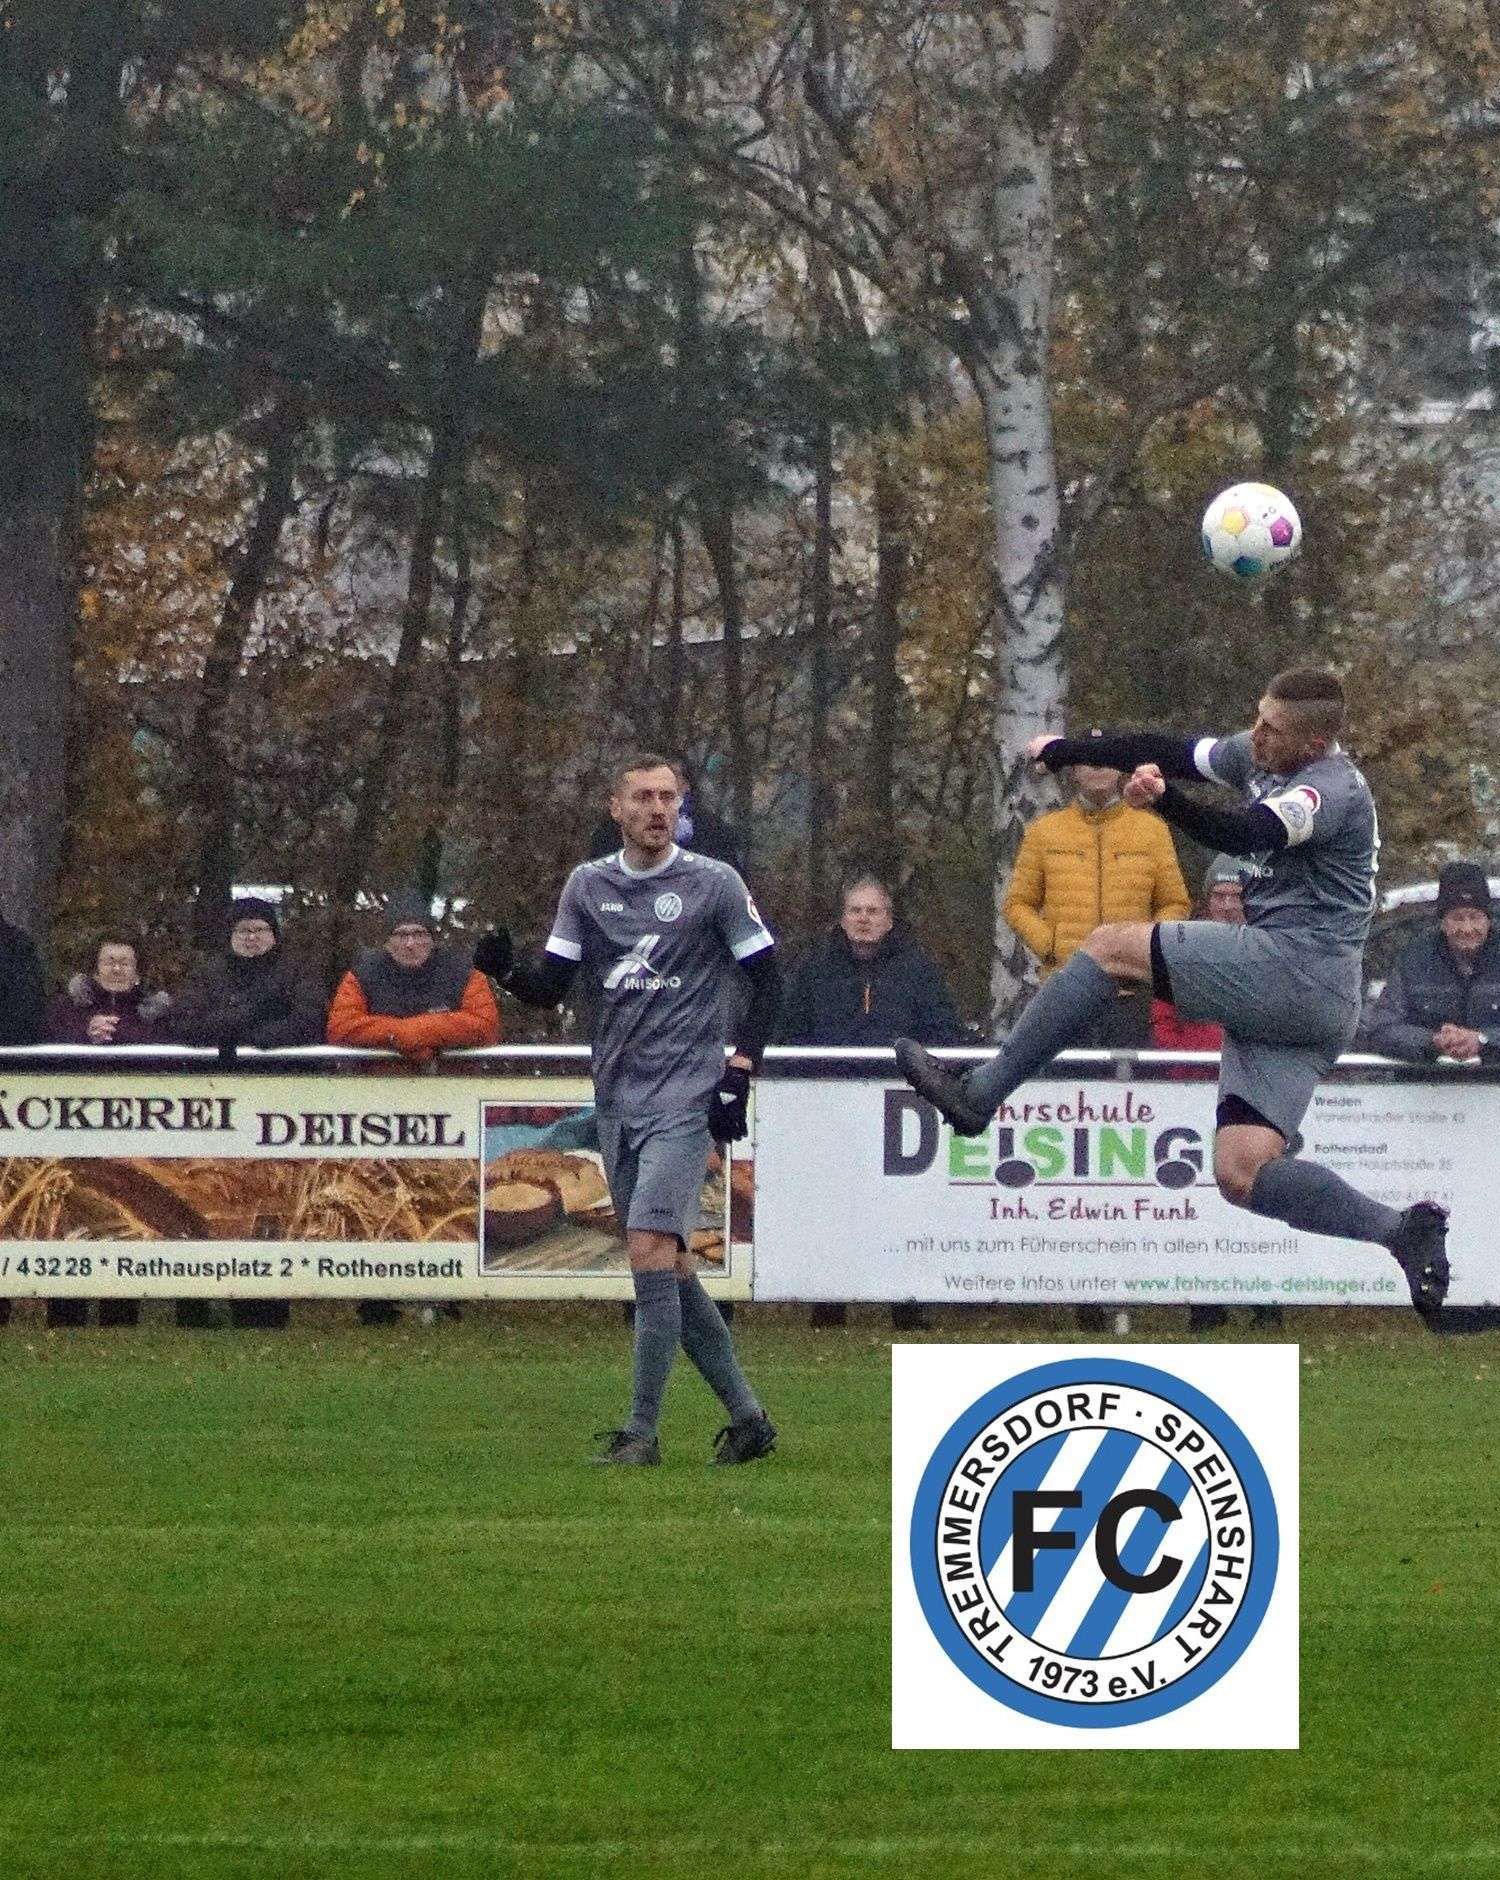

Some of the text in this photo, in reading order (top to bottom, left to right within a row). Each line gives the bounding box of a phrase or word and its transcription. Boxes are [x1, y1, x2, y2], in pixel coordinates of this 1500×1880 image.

[256, 1112, 466, 1147] DEISEL
[990, 1197, 1200, 1221] Inh. Edwin Funk
[906, 1236, 935, 1252] mit
[941, 1239, 972, 1253] uns
[977, 1239, 1015, 1253] zum
[1020, 1235, 1138, 1254] Führerschein
[1143, 1236, 1160, 1253] in
[1164, 1236, 1209, 1254] allen
[117, 1257, 273, 1282] Rathausplatz
[280, 1258, 293, 1278] 2
[318, 1258, 463, 1279] Rothenstadt
[944, 1272, 1397, 1296] Weitere Infos unter www.fahrschule-deisinger.de
